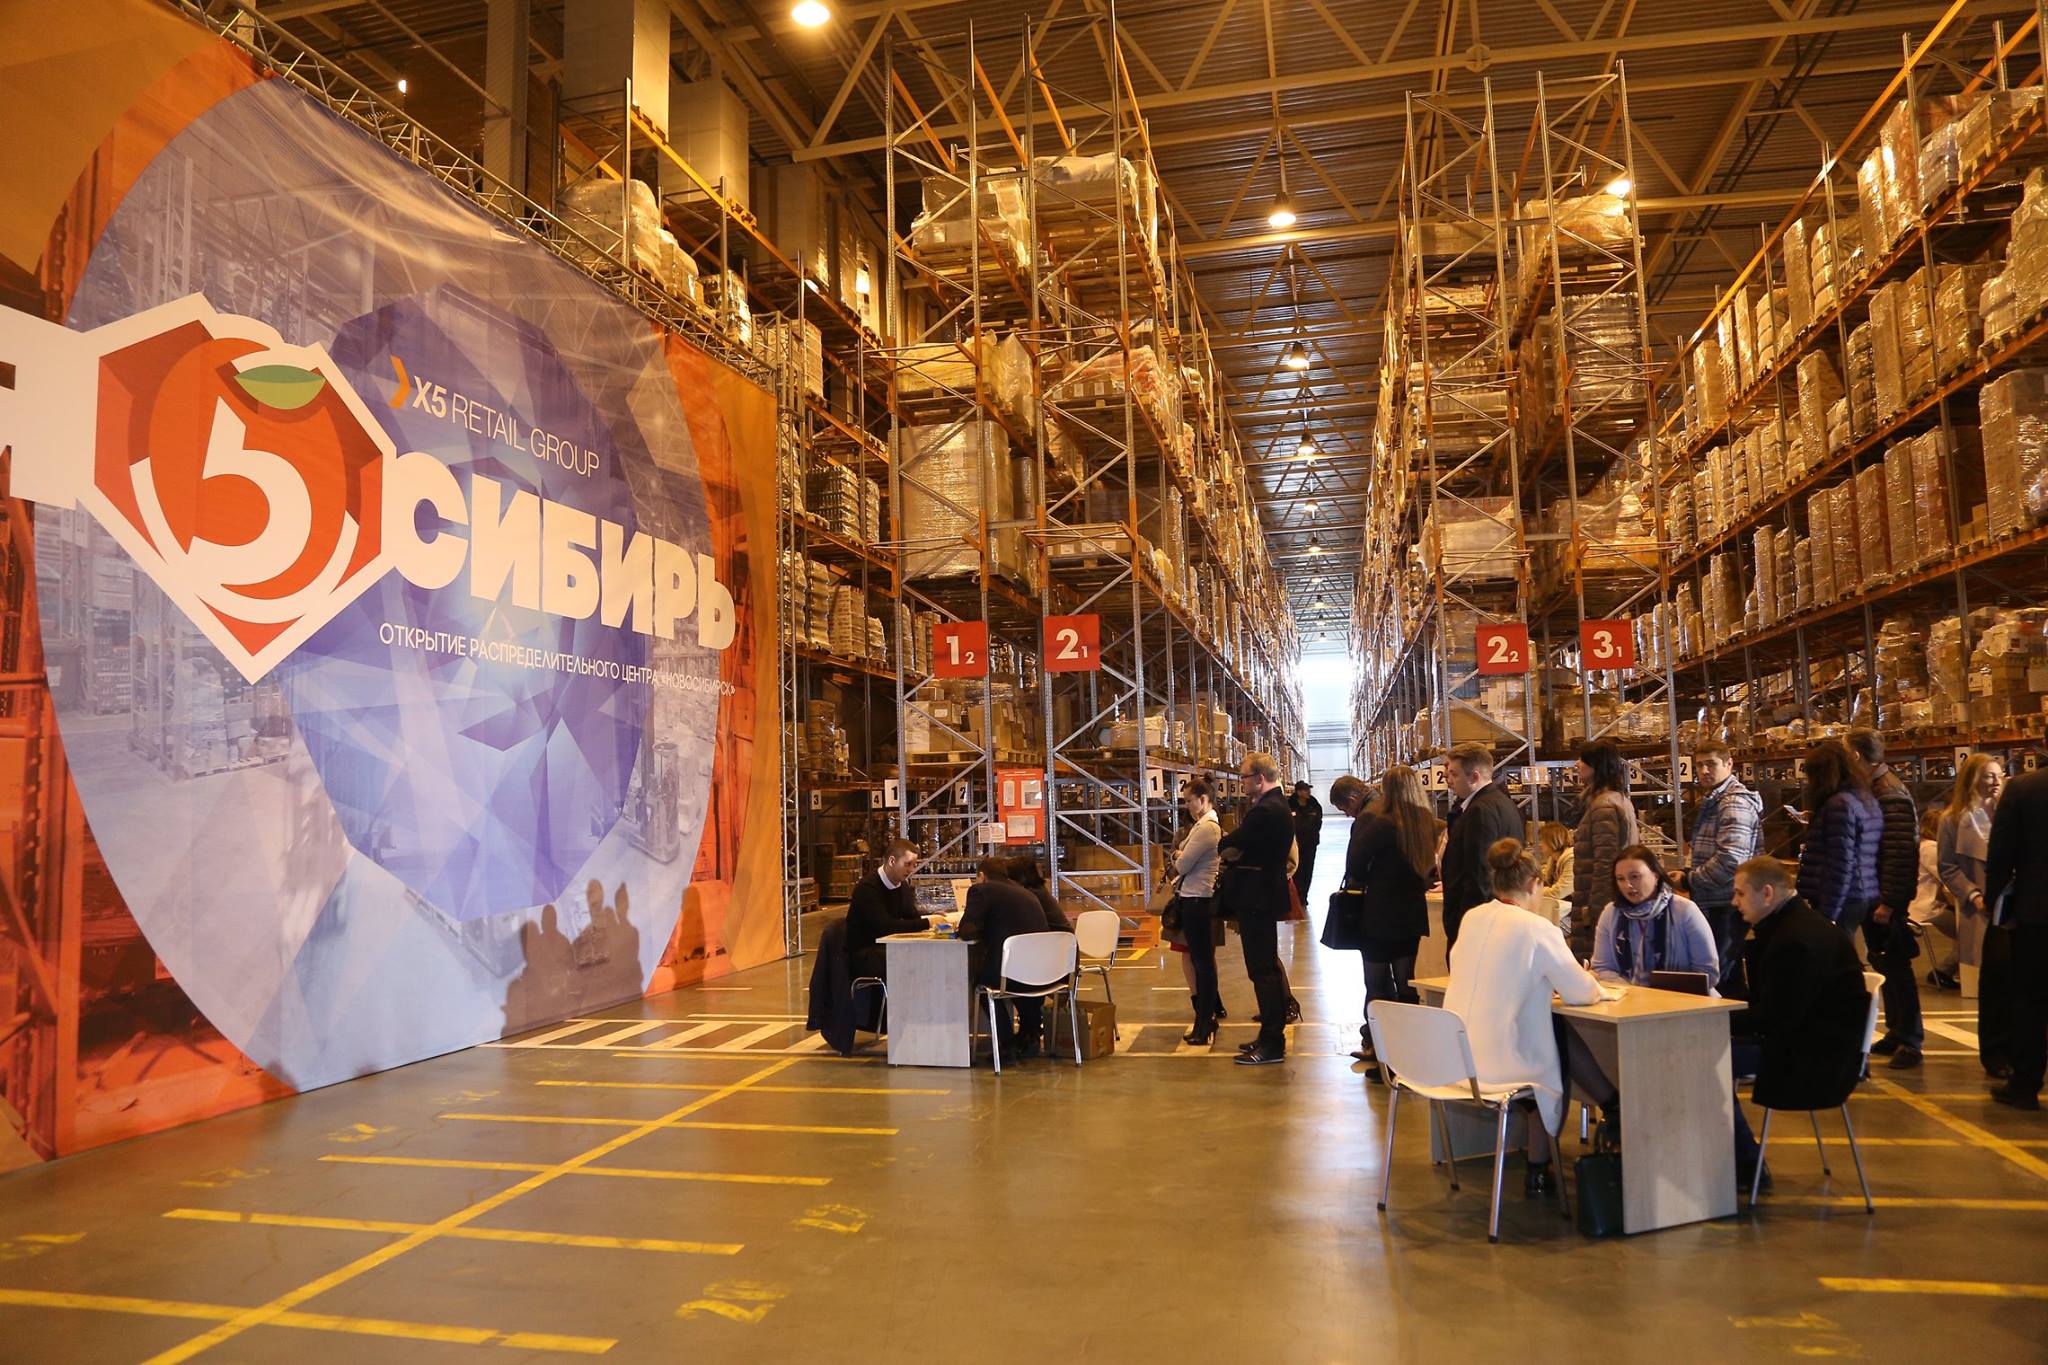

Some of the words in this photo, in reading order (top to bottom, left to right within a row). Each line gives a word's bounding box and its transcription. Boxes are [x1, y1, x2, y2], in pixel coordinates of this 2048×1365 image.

[412, 375, 448, 418] X5
[452, 393, 526, 452] RETAIL
[530, 428, 600, 478] GROUP
[388, 452, 736, 650] СИБИРЬ
[379, 622, 466, 656] ОТКРЫТИЕ
[470, 638, 620, 680] РАСПРЕДЕЛИТЕЛЬНОГО
[622, 664, 658, 686] ЦЕНТРА
[1630, 768, 1637, 779] 3
[1680, 762, 1687, 776] 2
[1150, 775, 1158, 791] 1
[1422, 774, 1429, 785] 3
[1436, 771, 1445, 784] 2
[891, 786, 898, 801] 1
[1218, 783, 1224, 793] 4
[1230, 784, 1236, 793] 5
[813, 795, 819, 805] 3
[873, 795, 880, 804] 4
